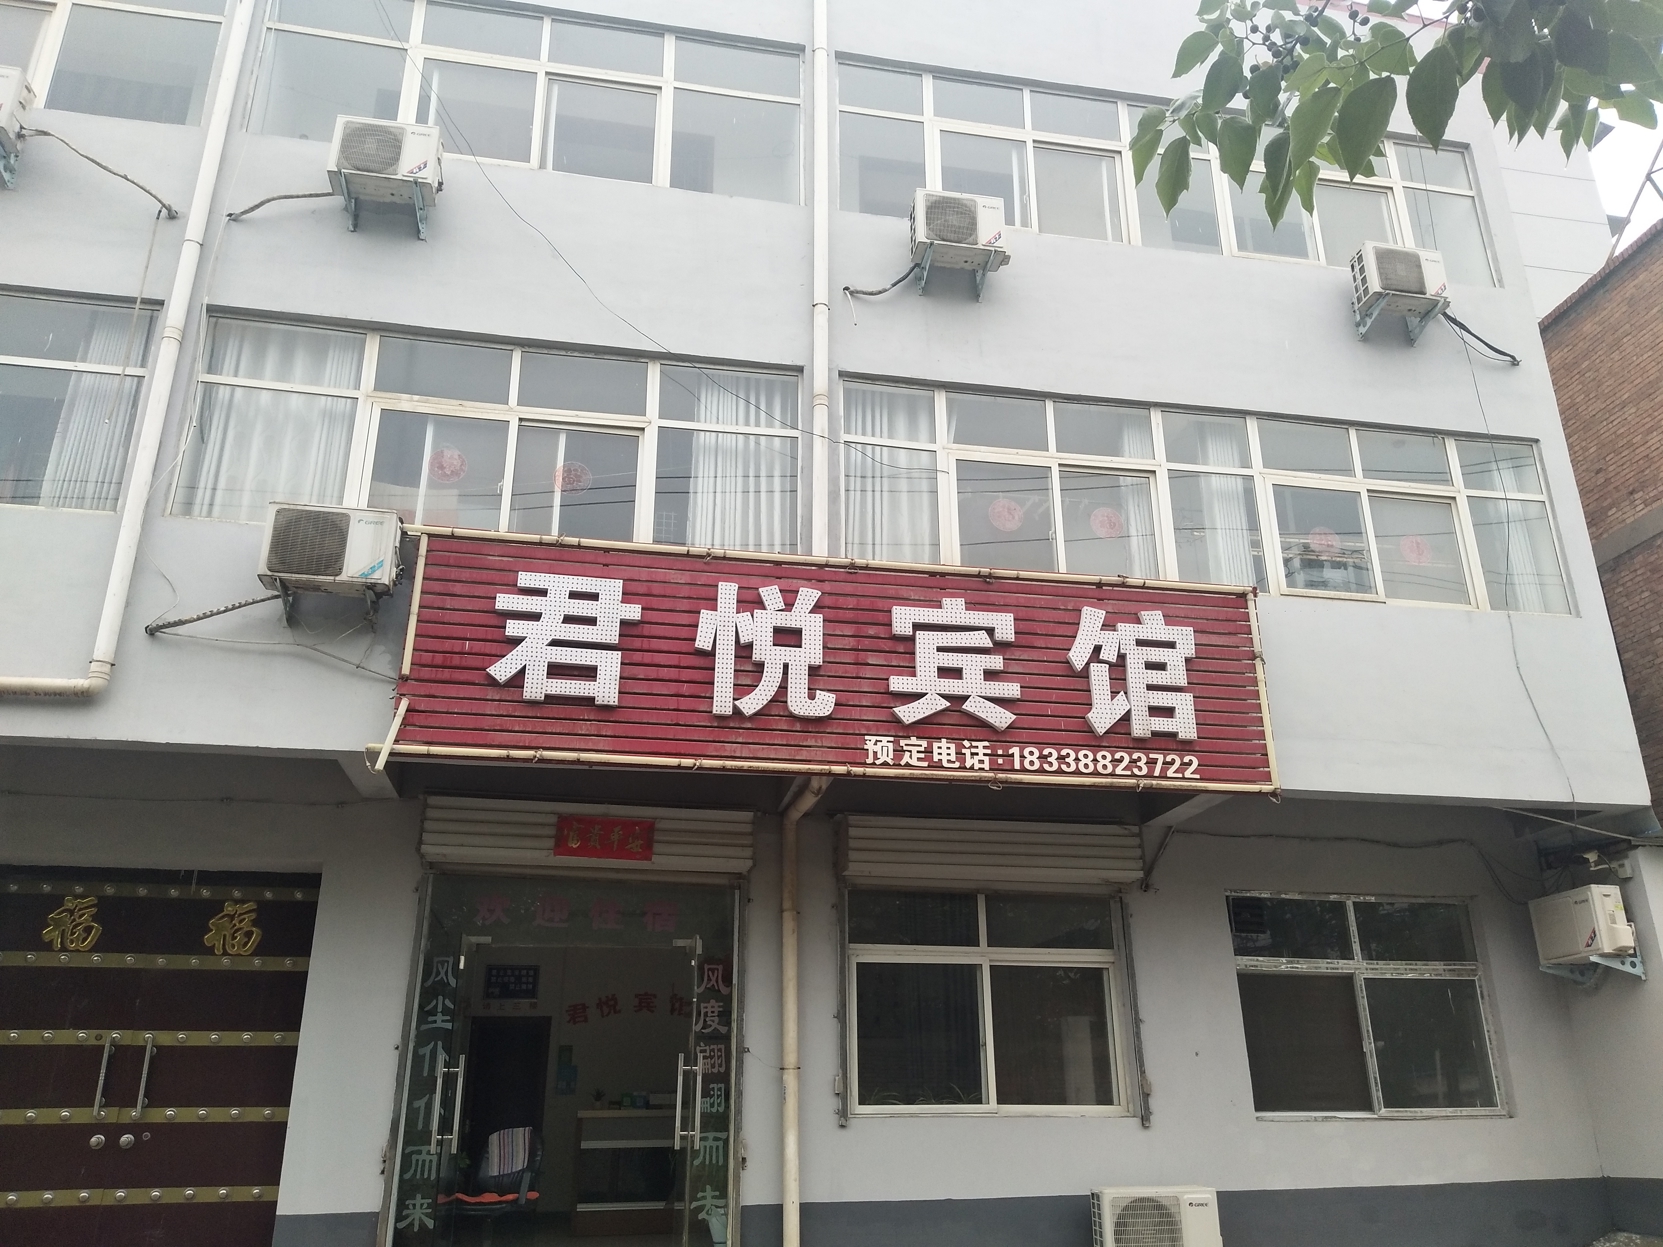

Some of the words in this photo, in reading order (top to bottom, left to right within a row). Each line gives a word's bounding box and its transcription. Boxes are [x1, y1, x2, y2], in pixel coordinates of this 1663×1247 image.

[486, 571, 1198, 741] 君悦宾馆
[42, 896, 102, 951] 福
[204, 902, 262, 955] 福
[473, 893, 680, 933] 欢迎住宿
